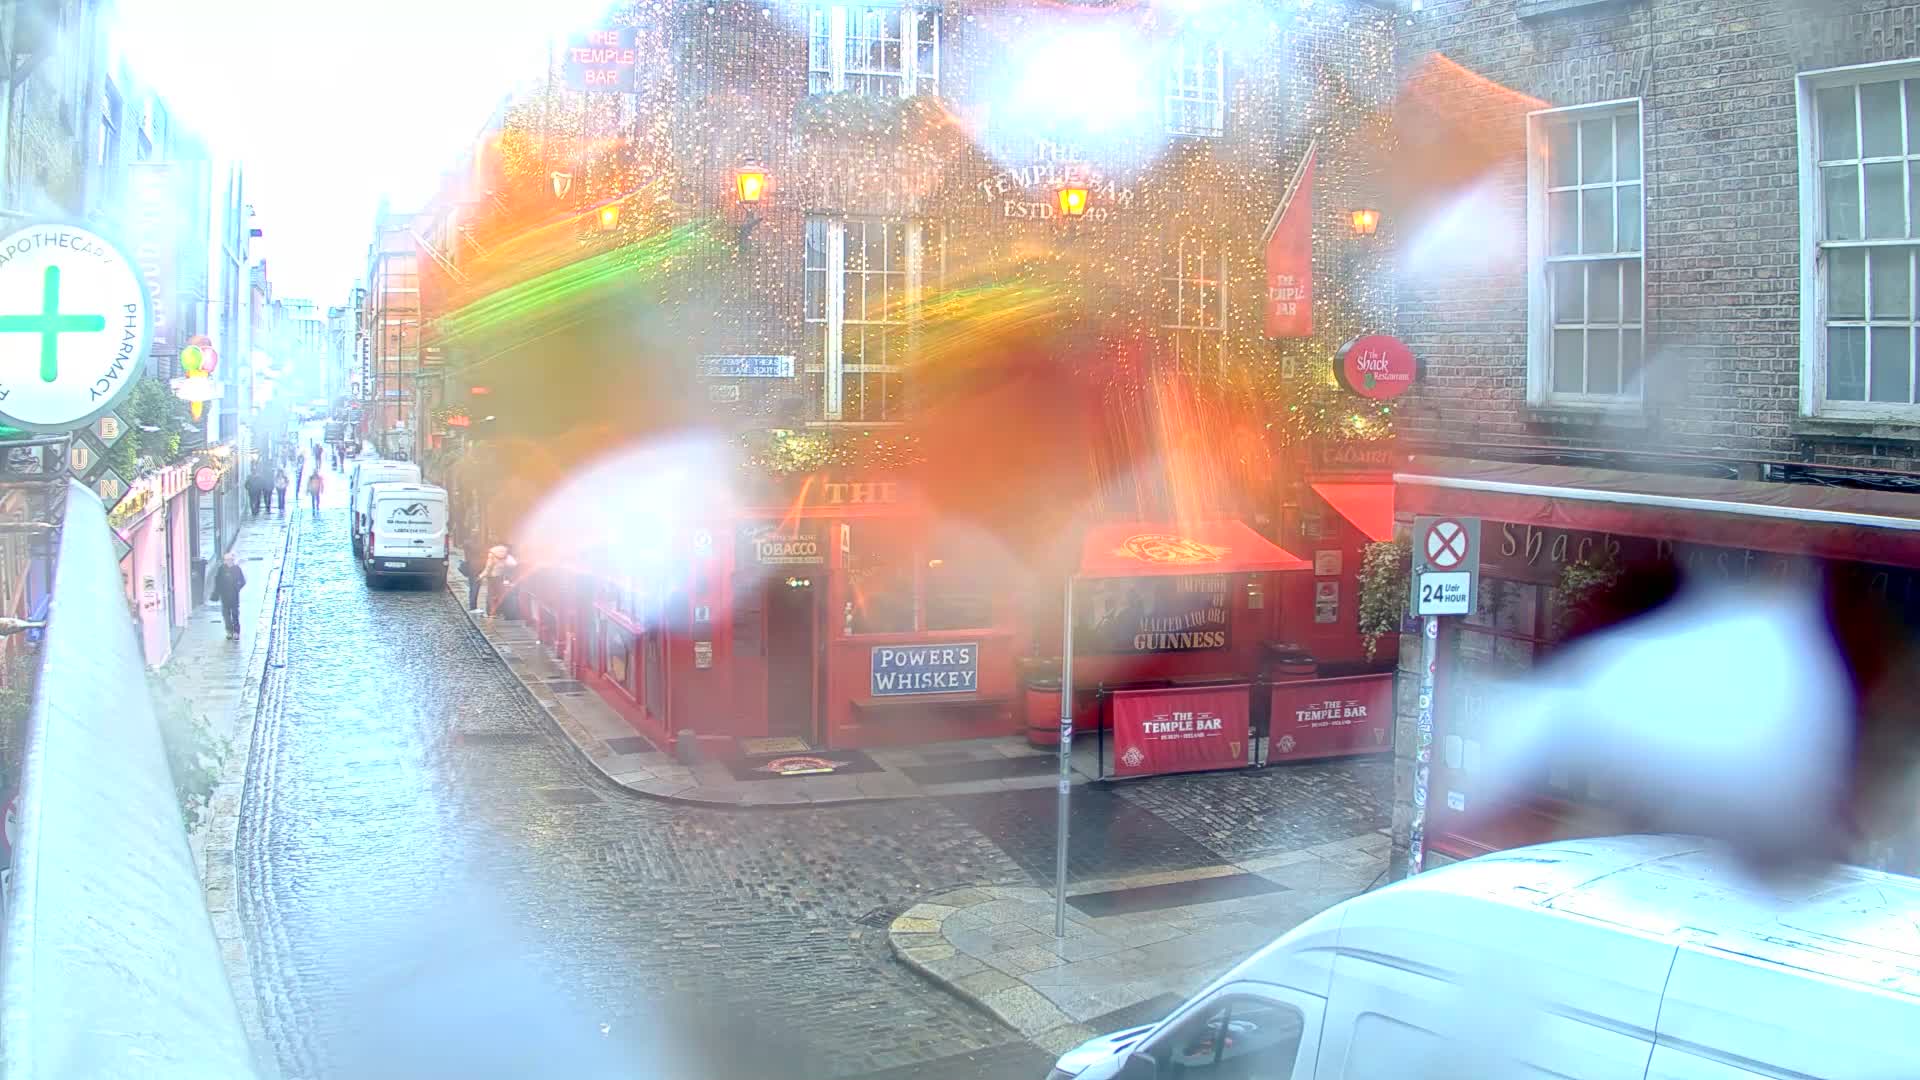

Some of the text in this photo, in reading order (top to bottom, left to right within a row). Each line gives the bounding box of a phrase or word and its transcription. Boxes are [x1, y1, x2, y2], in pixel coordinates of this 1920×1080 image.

[570, 47, 634, 64] TEMPLE
[585, 69, 618, 84] BAR
[978, 163, 1135, 210] TEMPLE BAR
[90, 303, 137, 402] PHARMACY
[1357, 349, 1389, 373] Shack
[752, 539, 818, 561] TOBACCO
[1422, 584, 1444, 603] 24
[1444, 594, 1466, 603] HOUR
[1134, 631, 1225, 650] GUINNESS
[880, 648, 970, 668] POWER'S
[874, 670, 976, 690] WHISKEY
[1296, 705, 1368, 722] TEMPLE BAR
[1323, 700, 1342, 709] THE
[1142, 718, 1223, 734] TEMPLE BAR
[1172, 712, 1194, 721] THE
